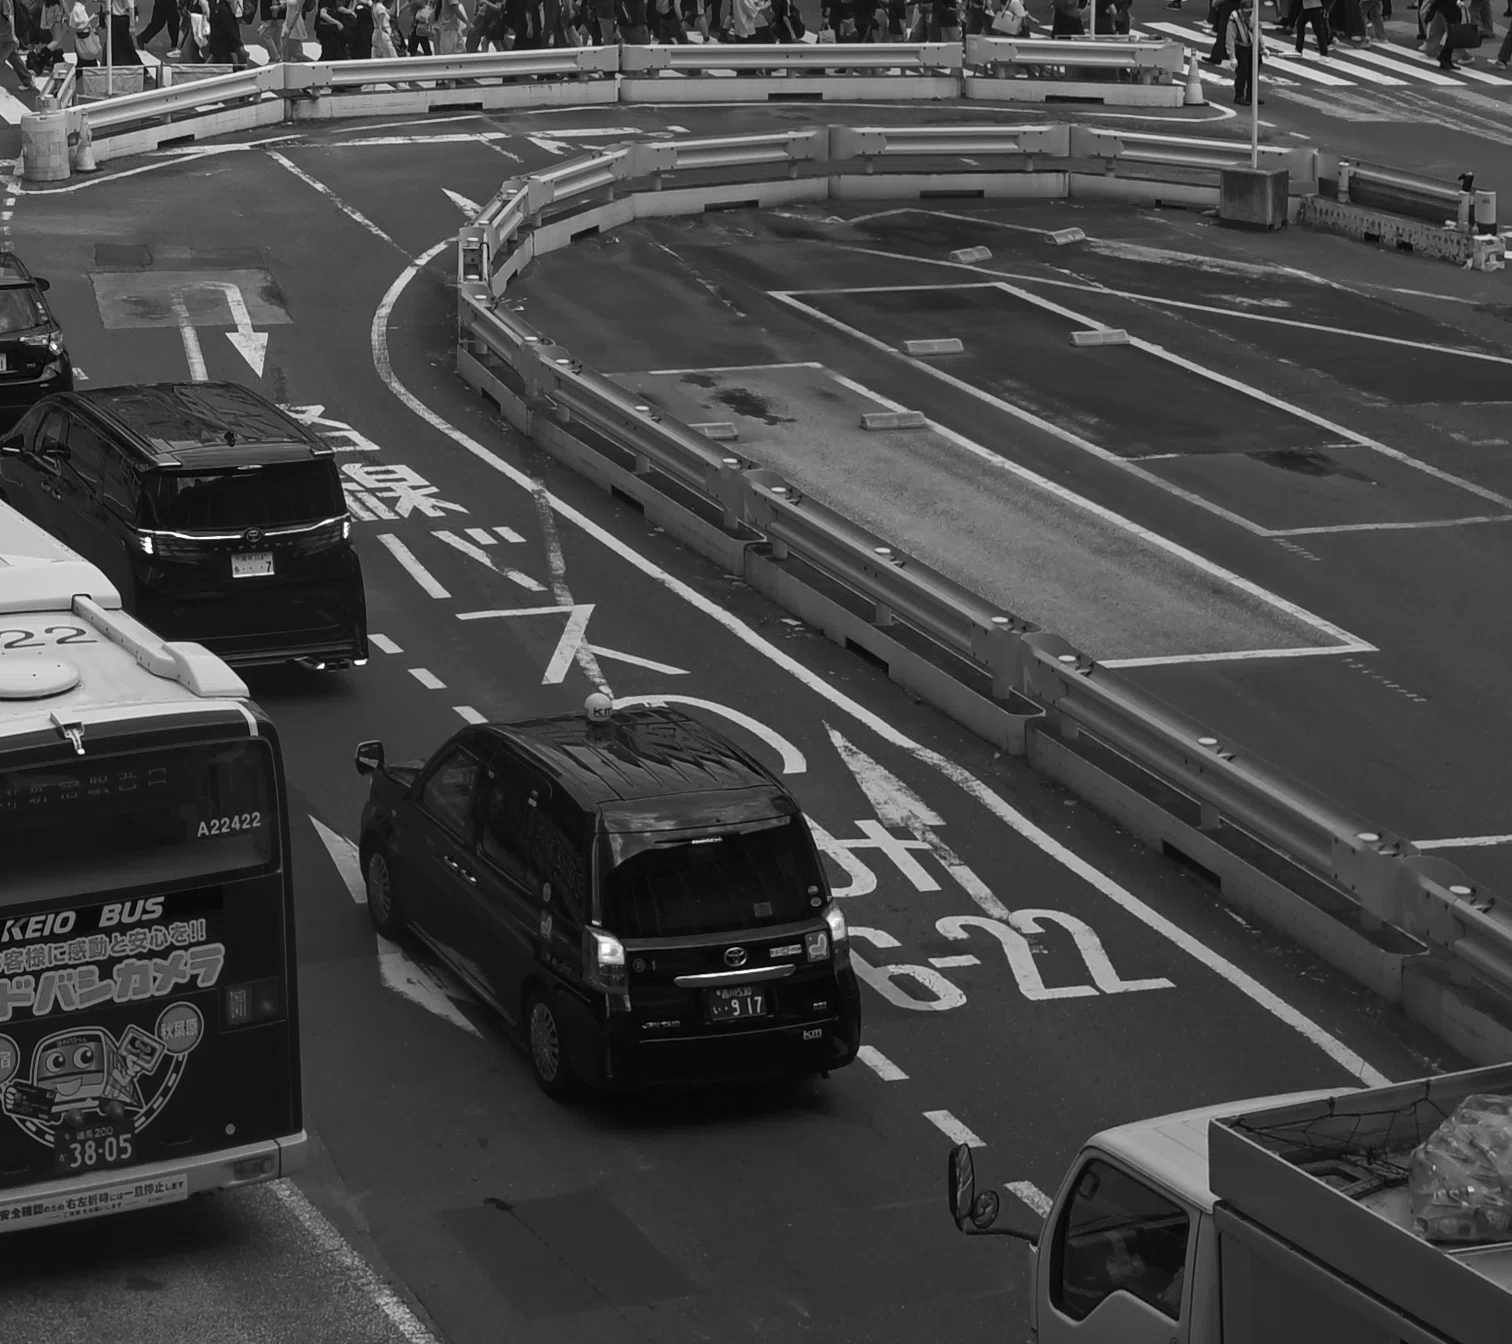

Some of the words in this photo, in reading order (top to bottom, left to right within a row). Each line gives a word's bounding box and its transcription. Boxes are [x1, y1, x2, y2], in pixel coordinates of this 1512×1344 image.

[196, 813, 262, 837] A22422
[2, 911, 77, 943] KEIO
[99, 897, 166, 929] BUS
[845, 909, 1180, 1013] 6-22
[160, 1018, 199, 1038] 秋葉原
[70, 1133, 133, 1169] 38-05
